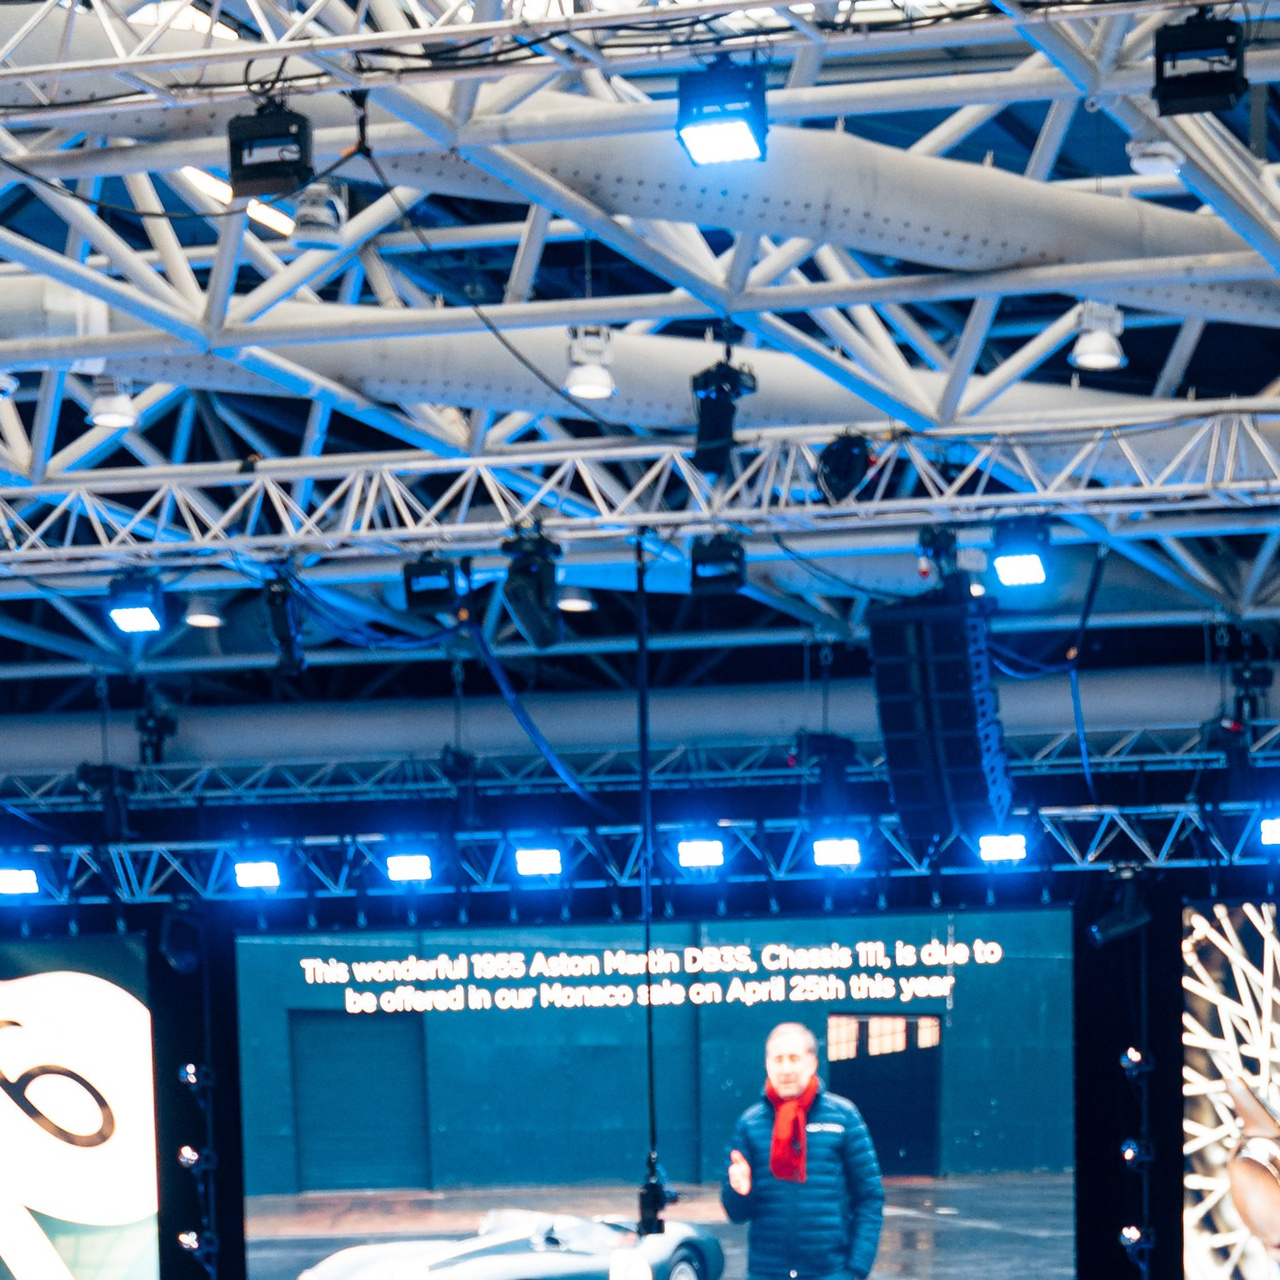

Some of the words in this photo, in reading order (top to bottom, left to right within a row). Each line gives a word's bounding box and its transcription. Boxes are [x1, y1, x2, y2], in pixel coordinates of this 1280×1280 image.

[300, 957, 349, 984] This
[352, 954, 468, 983] wonderful
[530, 951, 600, 977] Aston
[603, 948, 680, 975] Martin
[895, 940, 917, 966] is
[920, 939, 969, 966] due
[973, 938, 1002, 963] to
[345, 987, 377, 1014] be
[379, 984, 465, 1013] offered
[468, 984, 492, 1010] in
[495, 987, 537, 1010] our
[540, 982, 634, 1008] Monaco
[689, 982, 722, 1004] on
[726, 975, 785, 1006] April
[850, 973, 896, 999] this
[900, 975, 955, 1003] year
